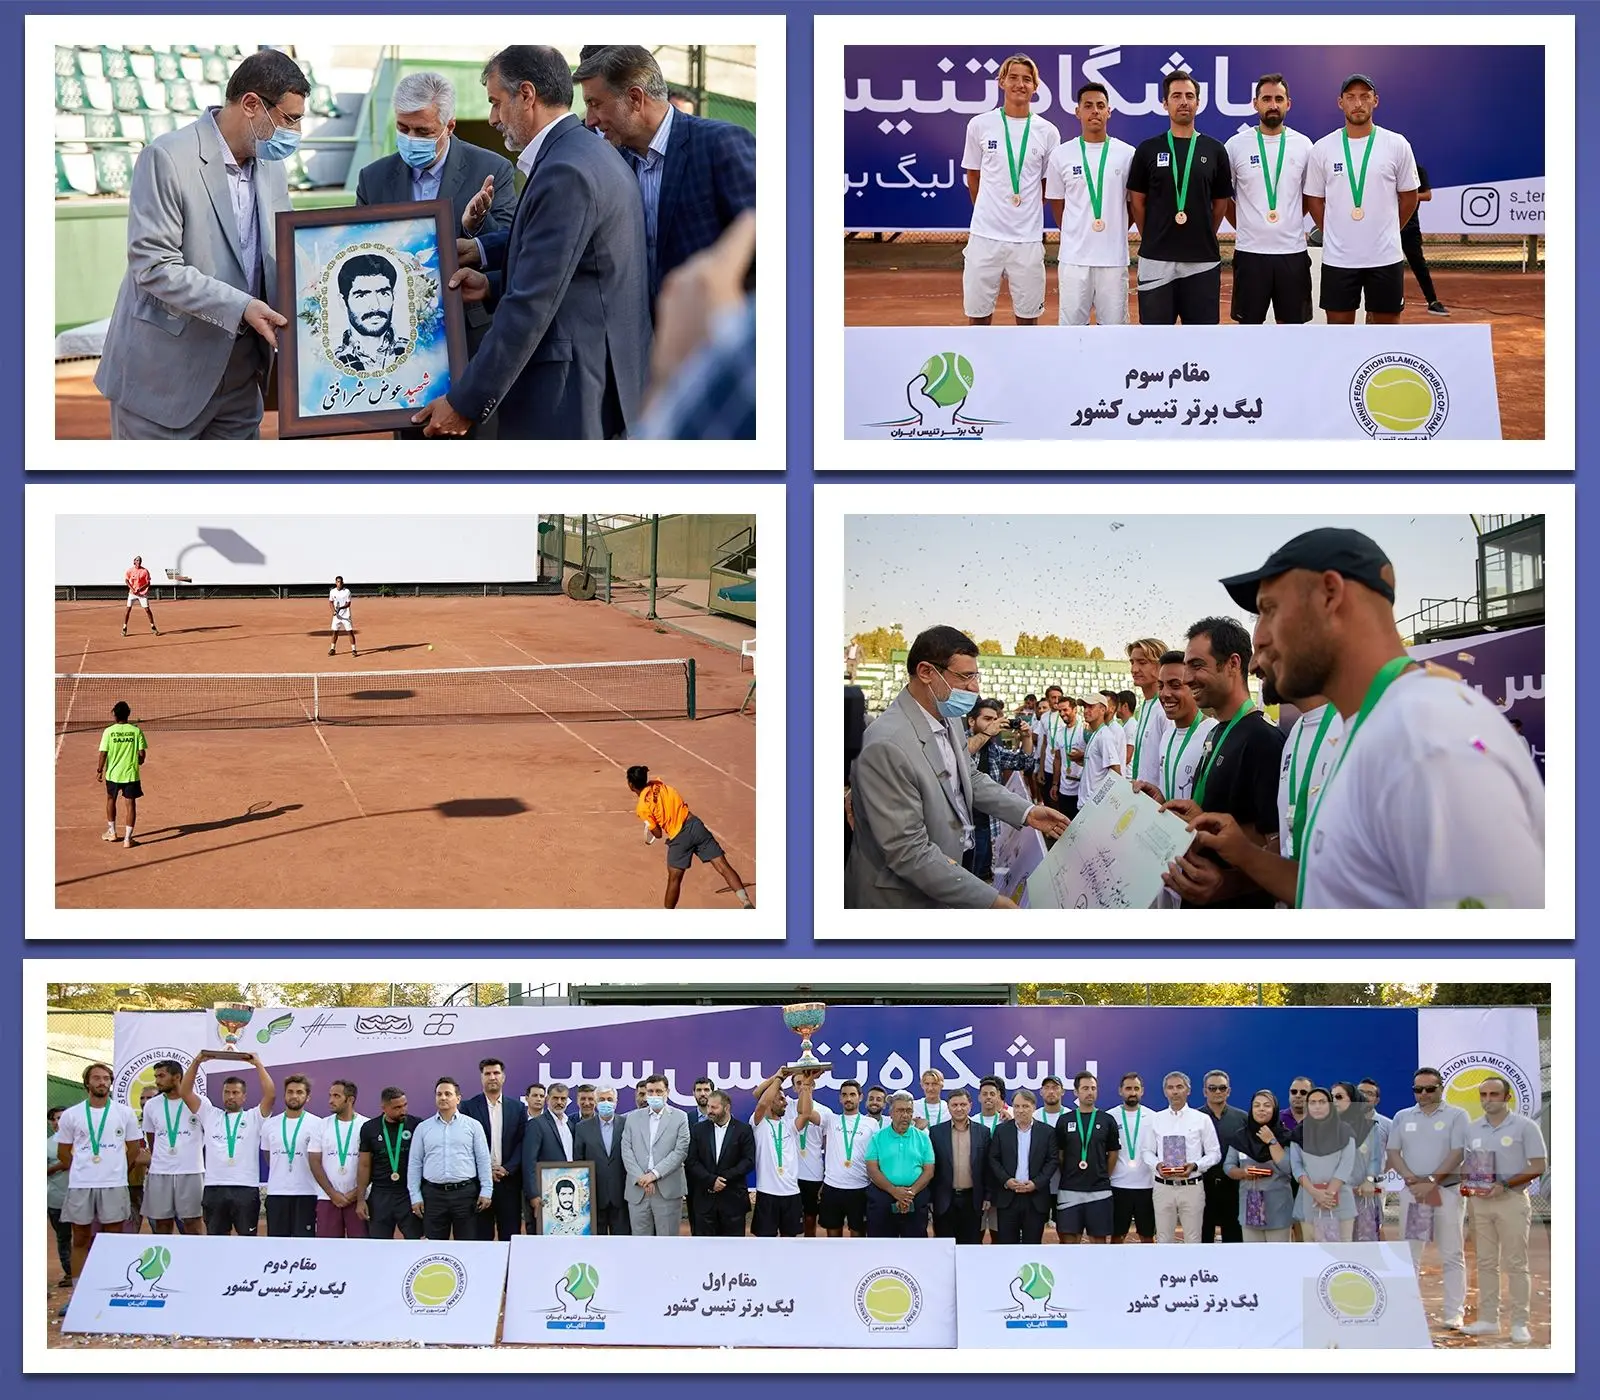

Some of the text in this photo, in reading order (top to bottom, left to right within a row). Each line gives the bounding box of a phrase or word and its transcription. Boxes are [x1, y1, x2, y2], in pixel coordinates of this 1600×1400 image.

[876, 153, 954, 198] لیگ
[404, 372, 430, 403] شهید
[1125, 362, 1210, 389] مقام سوم
[369, 380, 403, 405] عوض
[1353, 355, 1446, 432] TENNIS FEDERATION ISLAMIC REPUBLIC OF IRAN
[1070, 397, 1263, 426] لیگ برتر تنیس کشور
[891, 426, 984, 437] لیگ برتر تنیس ایران
[116, 1053, 153, 1101] FEDERATION
[153, 1050, 185, 1062] ISLAMIC
[663, 1042, 870, 1107] تنس
[1467, 1055, 1505, 1068] ISLAMIC
[1503, 1064, 1530, 1103] REPUBLIC
[263, 1257, 317, 1274] مقام دوم
[1159, 1269, 1219, 1288] مقام سوم
[222, 1279, 347, 1299] لیگ برتر تنیس کشور
[702, 1272, 758, 1291] مقام اول
[663, 1298, 795, 1317] لیگ برتر تنیس کشور
[1126, 1293, 1259, 1313] لیگ برتر تنیس کشور
